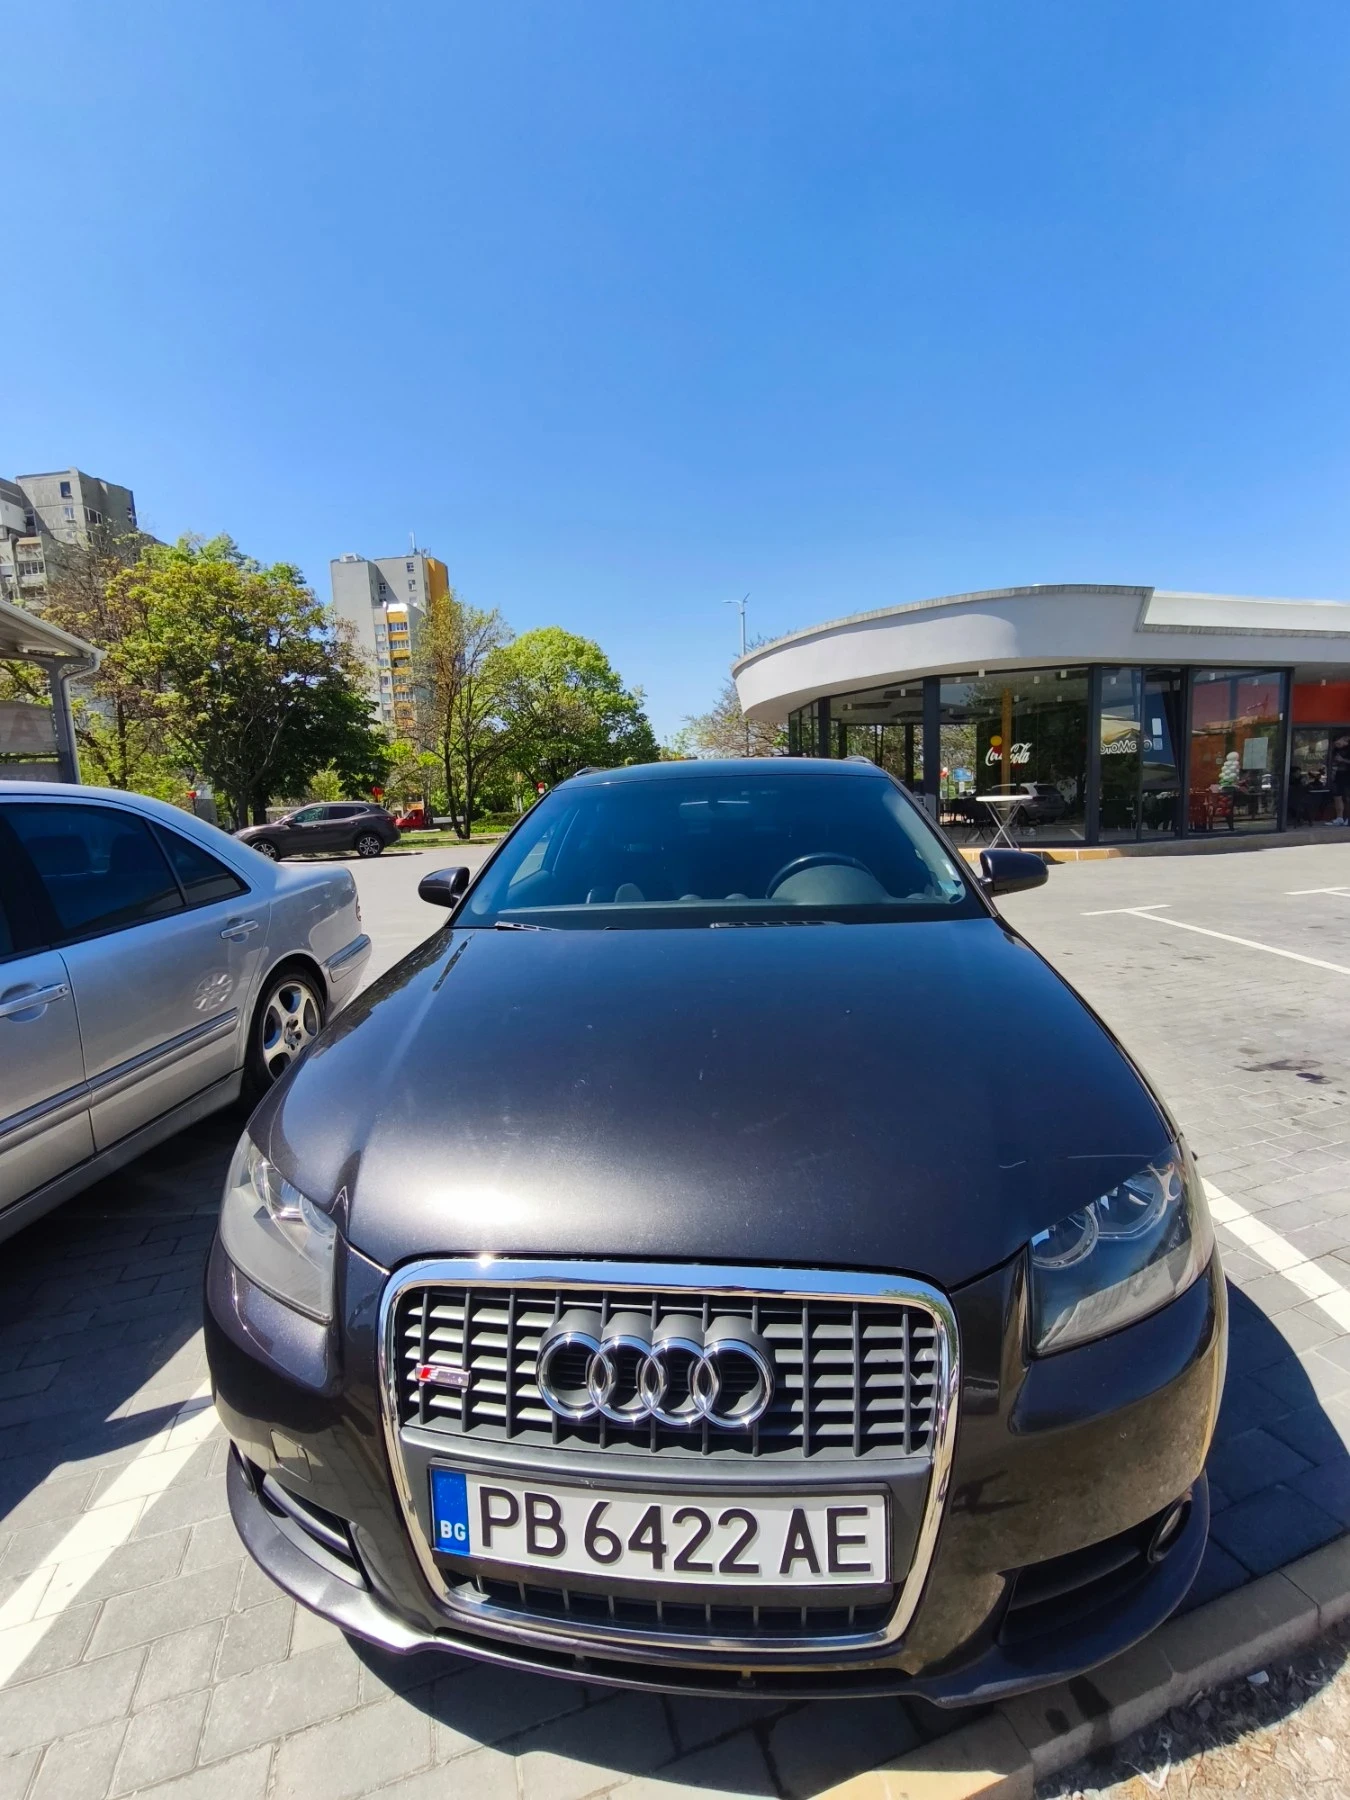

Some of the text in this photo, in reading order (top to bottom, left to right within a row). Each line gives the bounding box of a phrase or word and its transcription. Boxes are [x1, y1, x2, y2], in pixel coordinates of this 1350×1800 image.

[985, 743, 1032, 767] CocaCola
[440, 1519, 466, 1541] BG
[479, 1486, 871, 1574] PB 6422 AE
